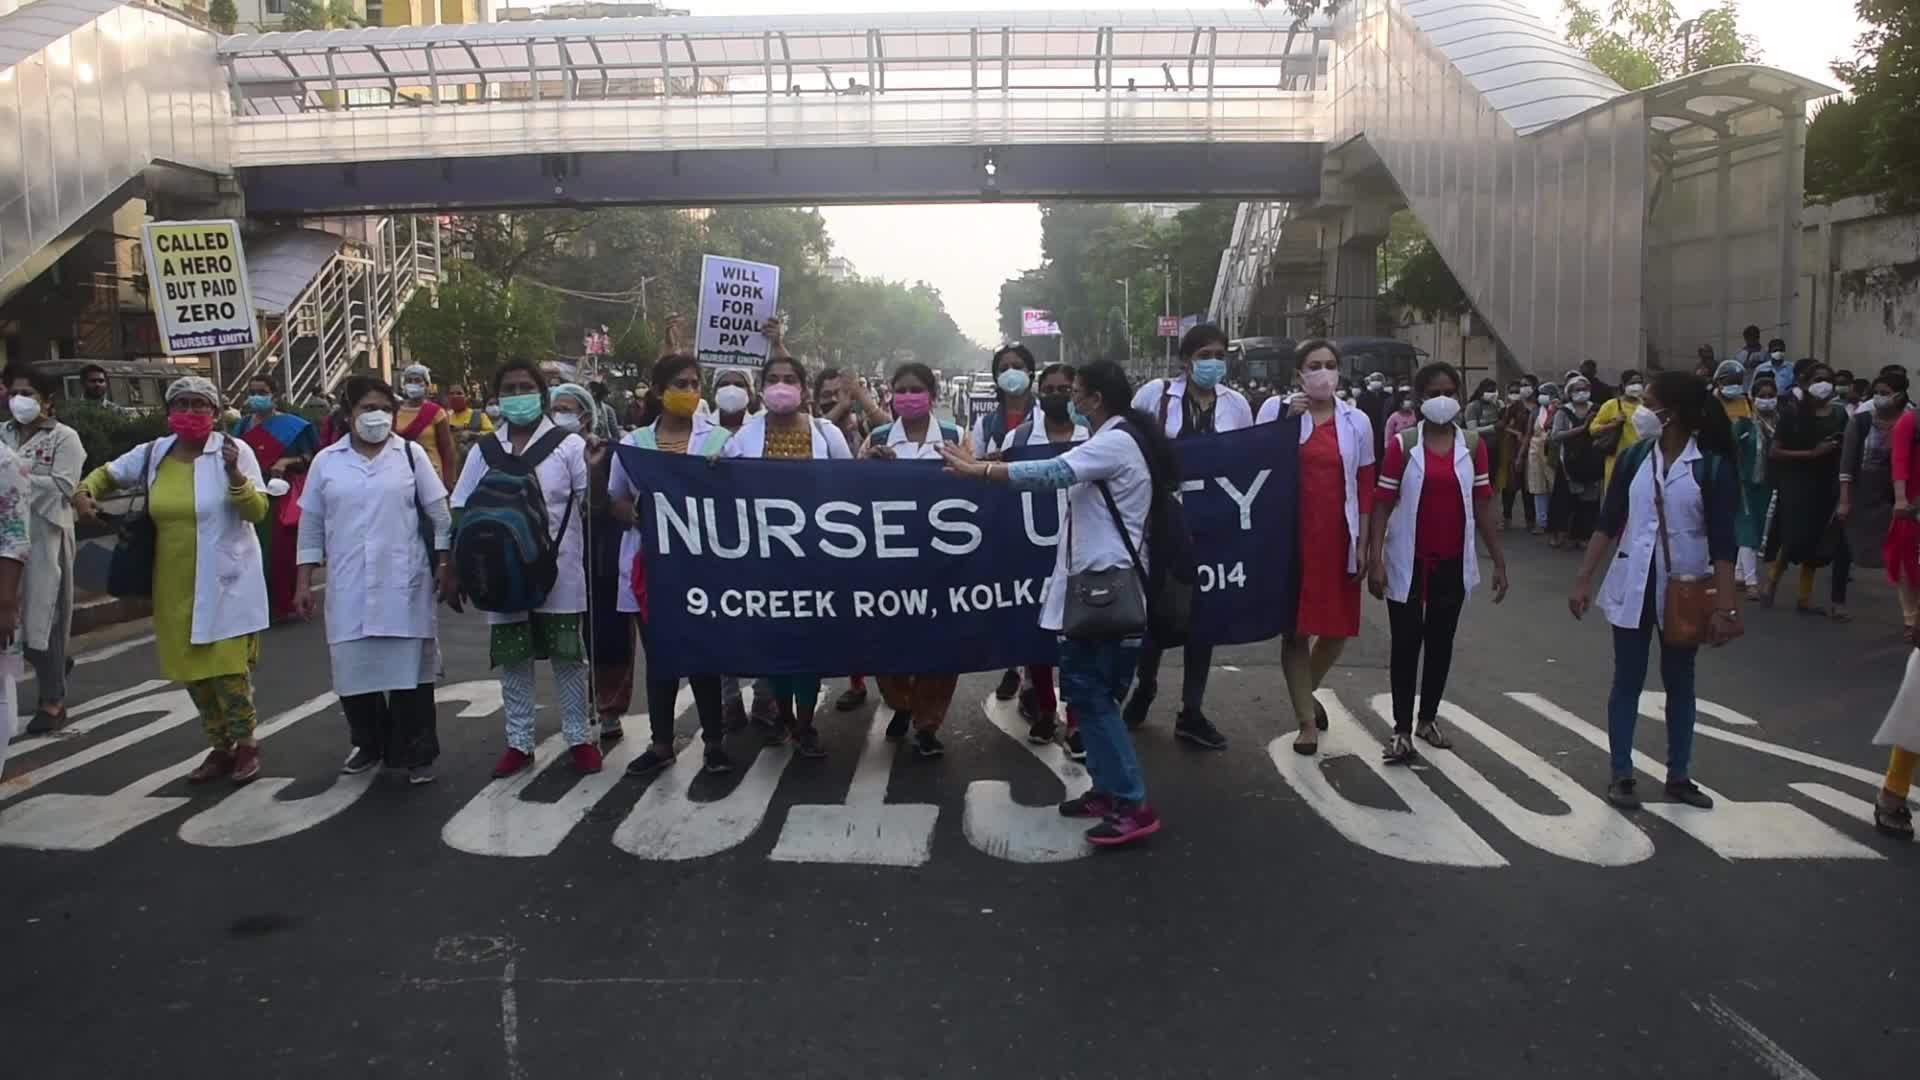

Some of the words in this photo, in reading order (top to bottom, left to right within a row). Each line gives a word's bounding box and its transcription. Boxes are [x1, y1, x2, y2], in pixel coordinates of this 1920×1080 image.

[156, 232, 229, 252] CALLED
[163, 258, 175, 276] A
[180, 255, 232, 275] HERO
[722, 266, 759, 283] WILL
[165, 281, 196, 300] BUT
[202, 278, 237, 297] PAID
[715, 281, 764, 300] WORK
[176, 302, 235, 323] ZERO
[722, 299, 753, 316] FOR
[709, 315, 762, 333] EQUAL
[218, 332, 249, 344] UNITY
[719, 333, 750, 346] PAY
[653, 491, 982, 559] NURSES
[853, 588, 938, 618] ROW,
